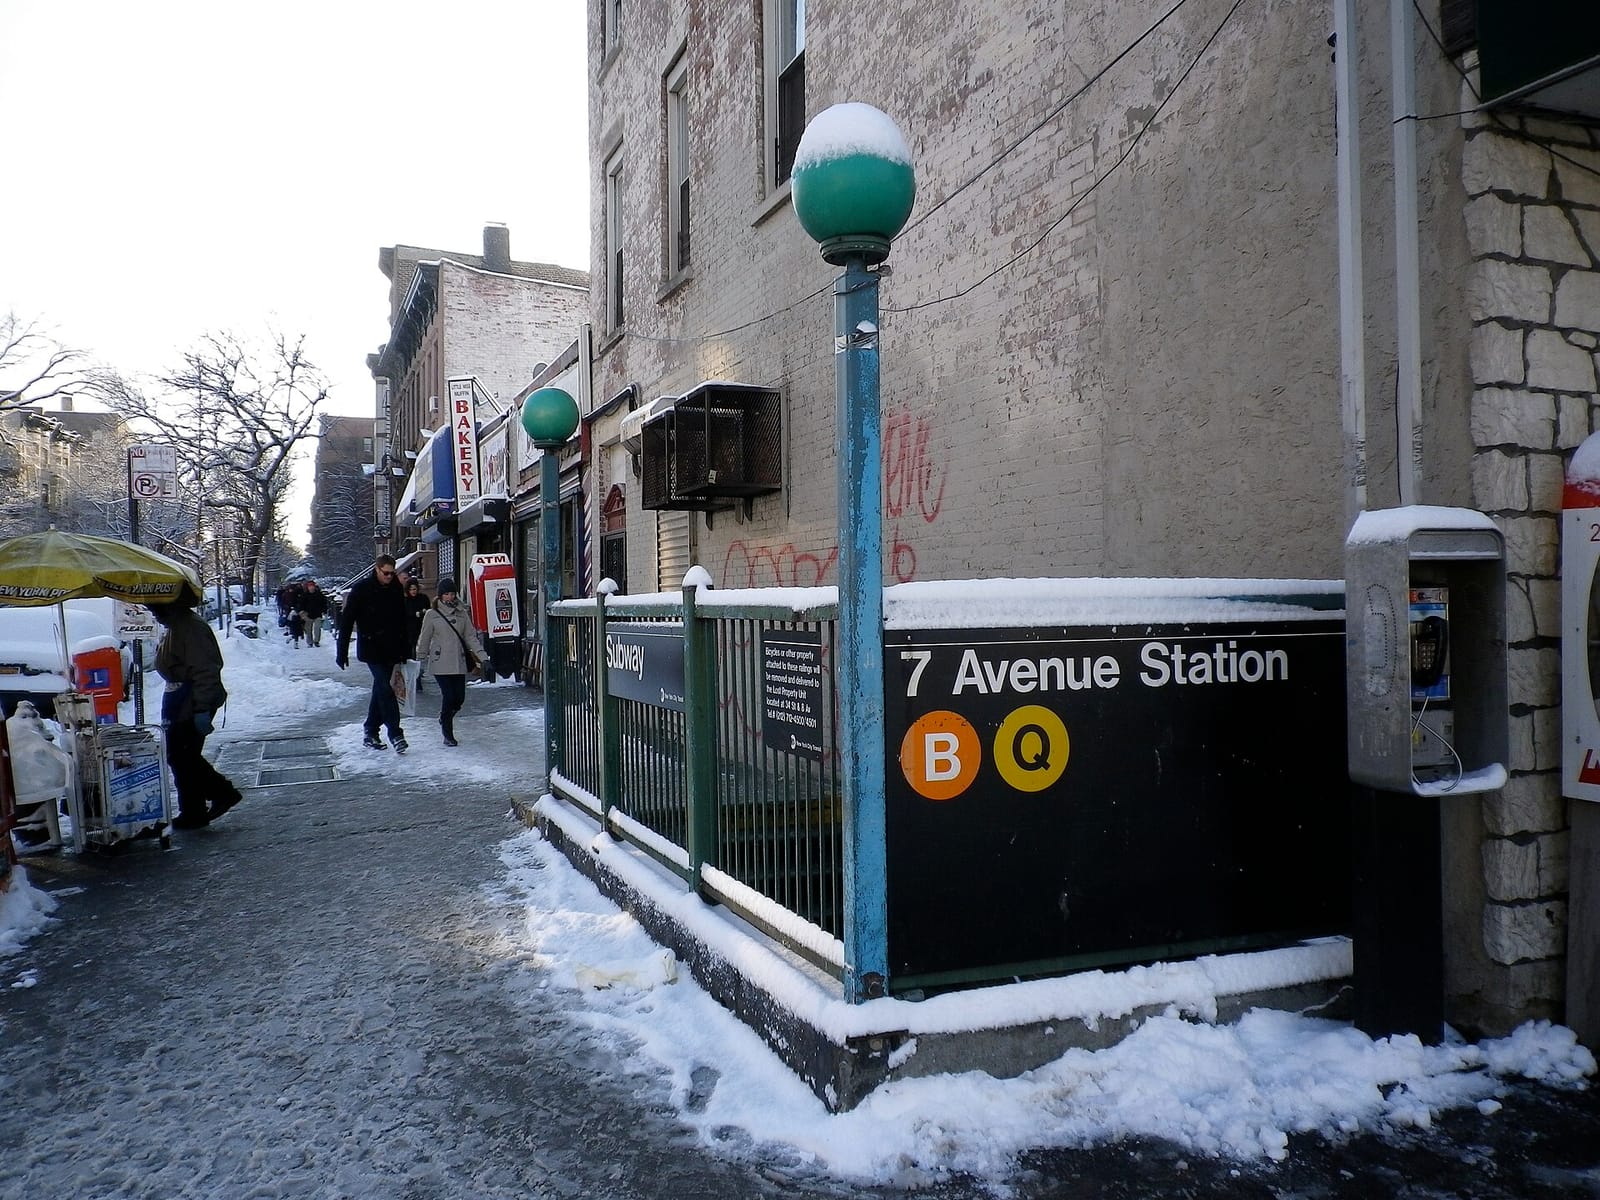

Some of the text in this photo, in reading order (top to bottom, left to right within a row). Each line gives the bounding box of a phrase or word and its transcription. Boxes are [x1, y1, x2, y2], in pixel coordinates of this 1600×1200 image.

[455, 400, 473, 491] BAKERY
[476, 556, 505, 564] ATM
[0, 585, 17, 595] EW
[19, 586, 49, 597] YORK
[154, 583, 176, 593] POST
[606, 634, 645, 681] Subway
[765, 647, 780, 657] Bicycles
[785, 649, 796, 657] other
[796, 651, 814, 661] property
[765, 660, 781, 669] attached
[787, 662, 798, 671] these
[798, 663, 812, 675] railings
[900, 640, 1289, 697] 7 Avenue Station
[771, 674, 787, 683] removed
[796, 676, 814, 687] delivered
[772, 685, 781, 695] Lost
[781, 686, 797, 699] Property
[798, 689, 806, 699] Unit
[766, 697, 779, 707] located
[923, 723, 1051, 782] B Q
